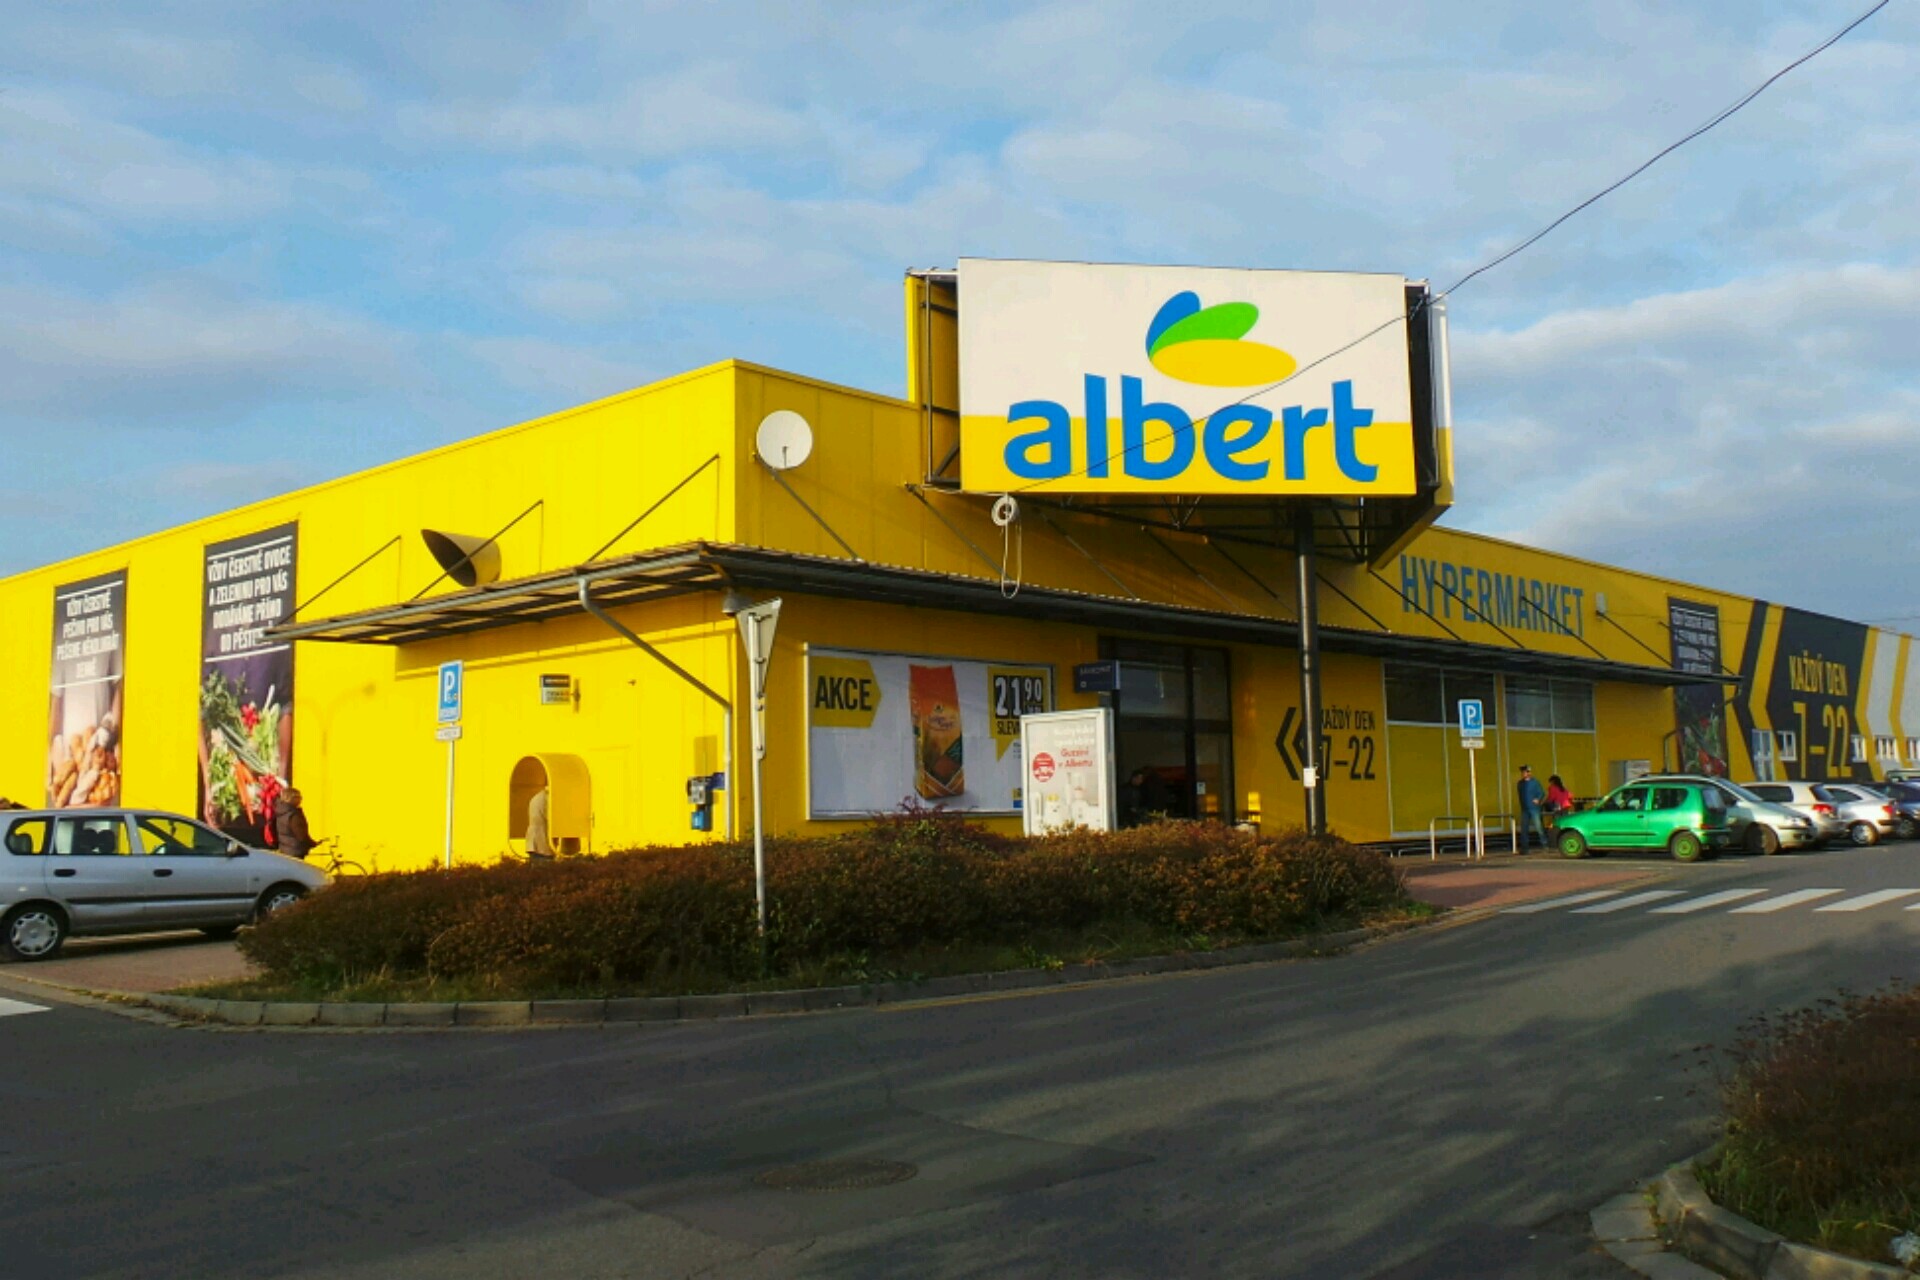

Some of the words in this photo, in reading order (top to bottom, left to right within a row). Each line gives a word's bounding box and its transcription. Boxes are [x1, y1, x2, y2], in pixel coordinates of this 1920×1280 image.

[1004, 373, 1379, 482] albert
[1400, 554, 1584, 640] HYPERMARKET
[443, 671, 456, 703] P
[1789, 650, 1825, 694] KAŽDÝ
[1824, 661, 1848, 696] DEN
[815, 675, 872, 711] AKCE
[1355, 710, 1376, 730] DEN
[1465, 704, 1477, 726] P
